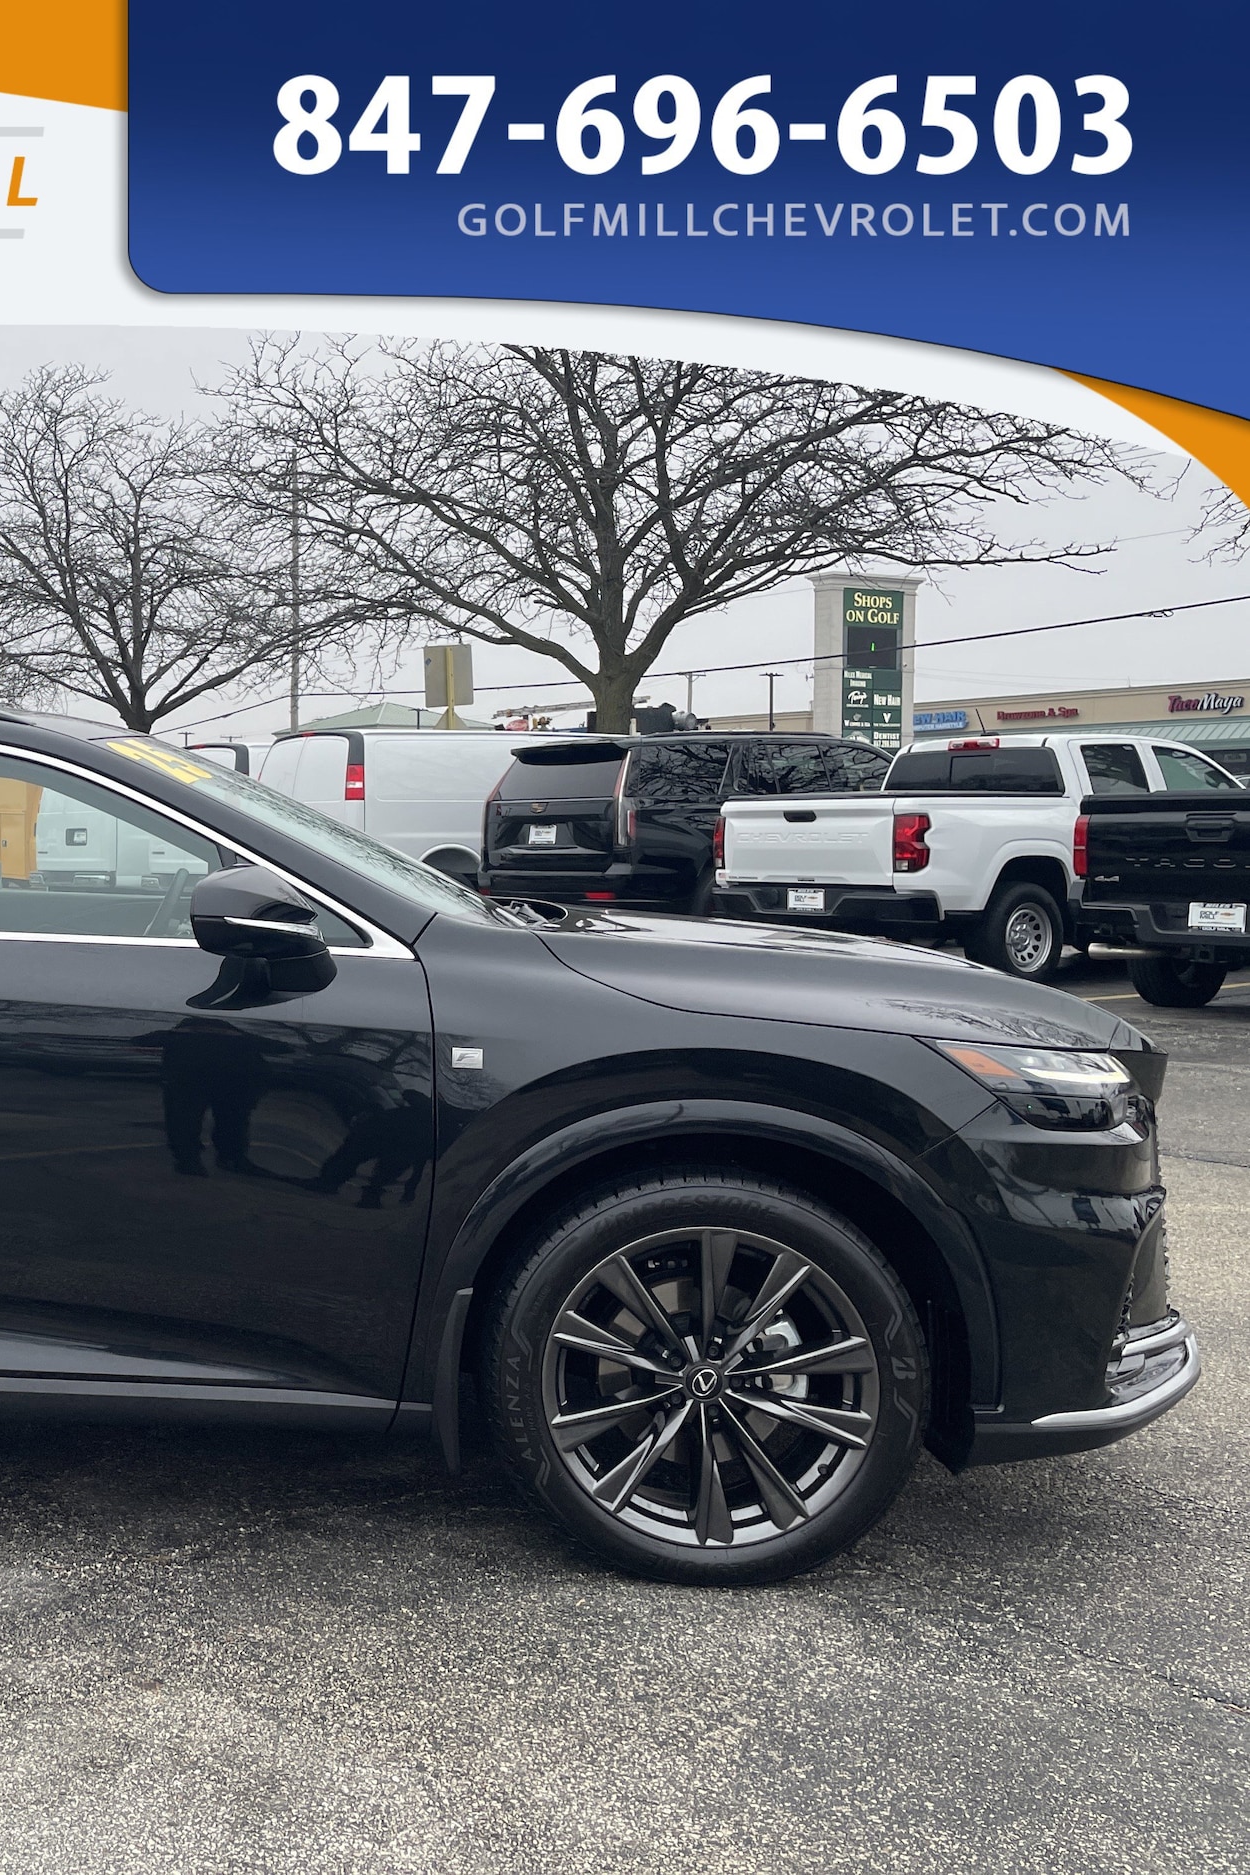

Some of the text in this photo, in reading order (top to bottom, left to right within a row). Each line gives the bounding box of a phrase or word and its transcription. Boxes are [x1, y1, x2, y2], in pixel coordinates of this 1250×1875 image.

[854, 592, 893, 609] SHOPS
[846, 608, 900, 625] ON GOLF
[913, 713, 933, 725] EW
[873, 731, 900, 740] DENTIST
[736, 832, 869, 844] CHEVROLET
[1125, 857, 1250, 869] TACO
[505, 1355, 537, 1463] ALENZA
